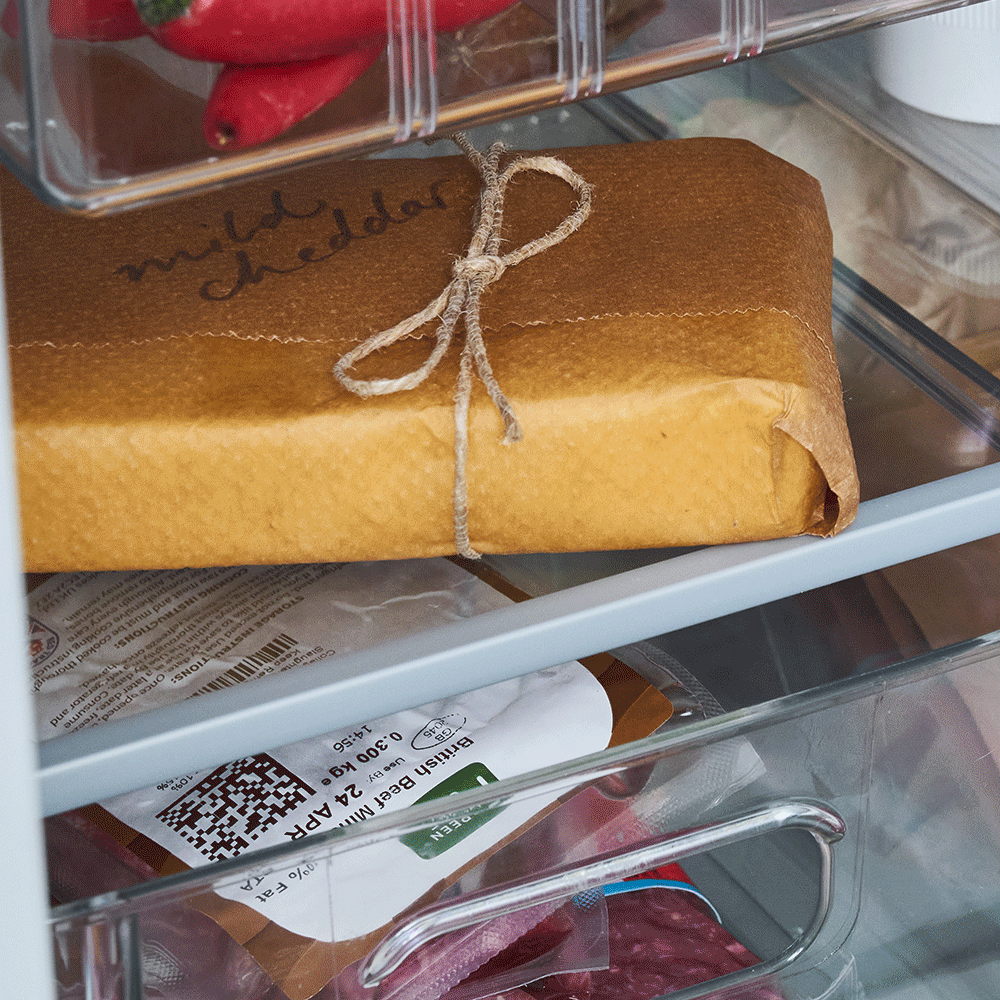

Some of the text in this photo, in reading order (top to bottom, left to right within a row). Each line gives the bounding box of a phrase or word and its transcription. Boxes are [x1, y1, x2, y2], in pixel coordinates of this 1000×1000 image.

[113, 190, 328, 283] mild
[199, 179, 451, 302] cheddar
[170, 580, 199, 601] meat
[197, 566, 248, 600] COOKING
[112, 575, 188, 624] comprehensive
[151, 595, 171, 613] and
[253, 594, 304, 630] STORAGE
[88, 605, 118, 627] every
[113, 595, 198, 650] INSTRUCTIONS:
[125, 608, 152, 627] must
[223, 611, 258, 639] exceed
[231, 604, 253, 621] like
[66, 625, 89, 642] care
[70, 620, 113, 652] cooking
[111, 624, 127, 638] be
[184, 618, 217, 645] within
[198, 625, 222, 646] save
[75, 633, 113, 663] cooked
[168, 640, 185, 655] the
[204, 636, 225, 653] Use
[272, 647, 300, 668] Keep
[122, 674, 148, 695] later
[138, 671, 166, 696] Once
[62, 688, 109, 730] Consume
[94, 690, 124, 714] date,
[48, 707, 70, 728] and
[331, 722, 373, 754] 14:56
[433, 725, 453, 744] GB
[354, 729, 403, 766] 0.300
[412, 733, 474, 781] British
[327, 759, 357, 782] kg
[382, 755, 405, 773] Use
[169, 772, 194, 793] 10%
[332, 780, 364, 810] 24
[371, 773, 417, 810] Beef
[282, 801, 335, 846] APR
[254, 879, 288, 906] Fat
